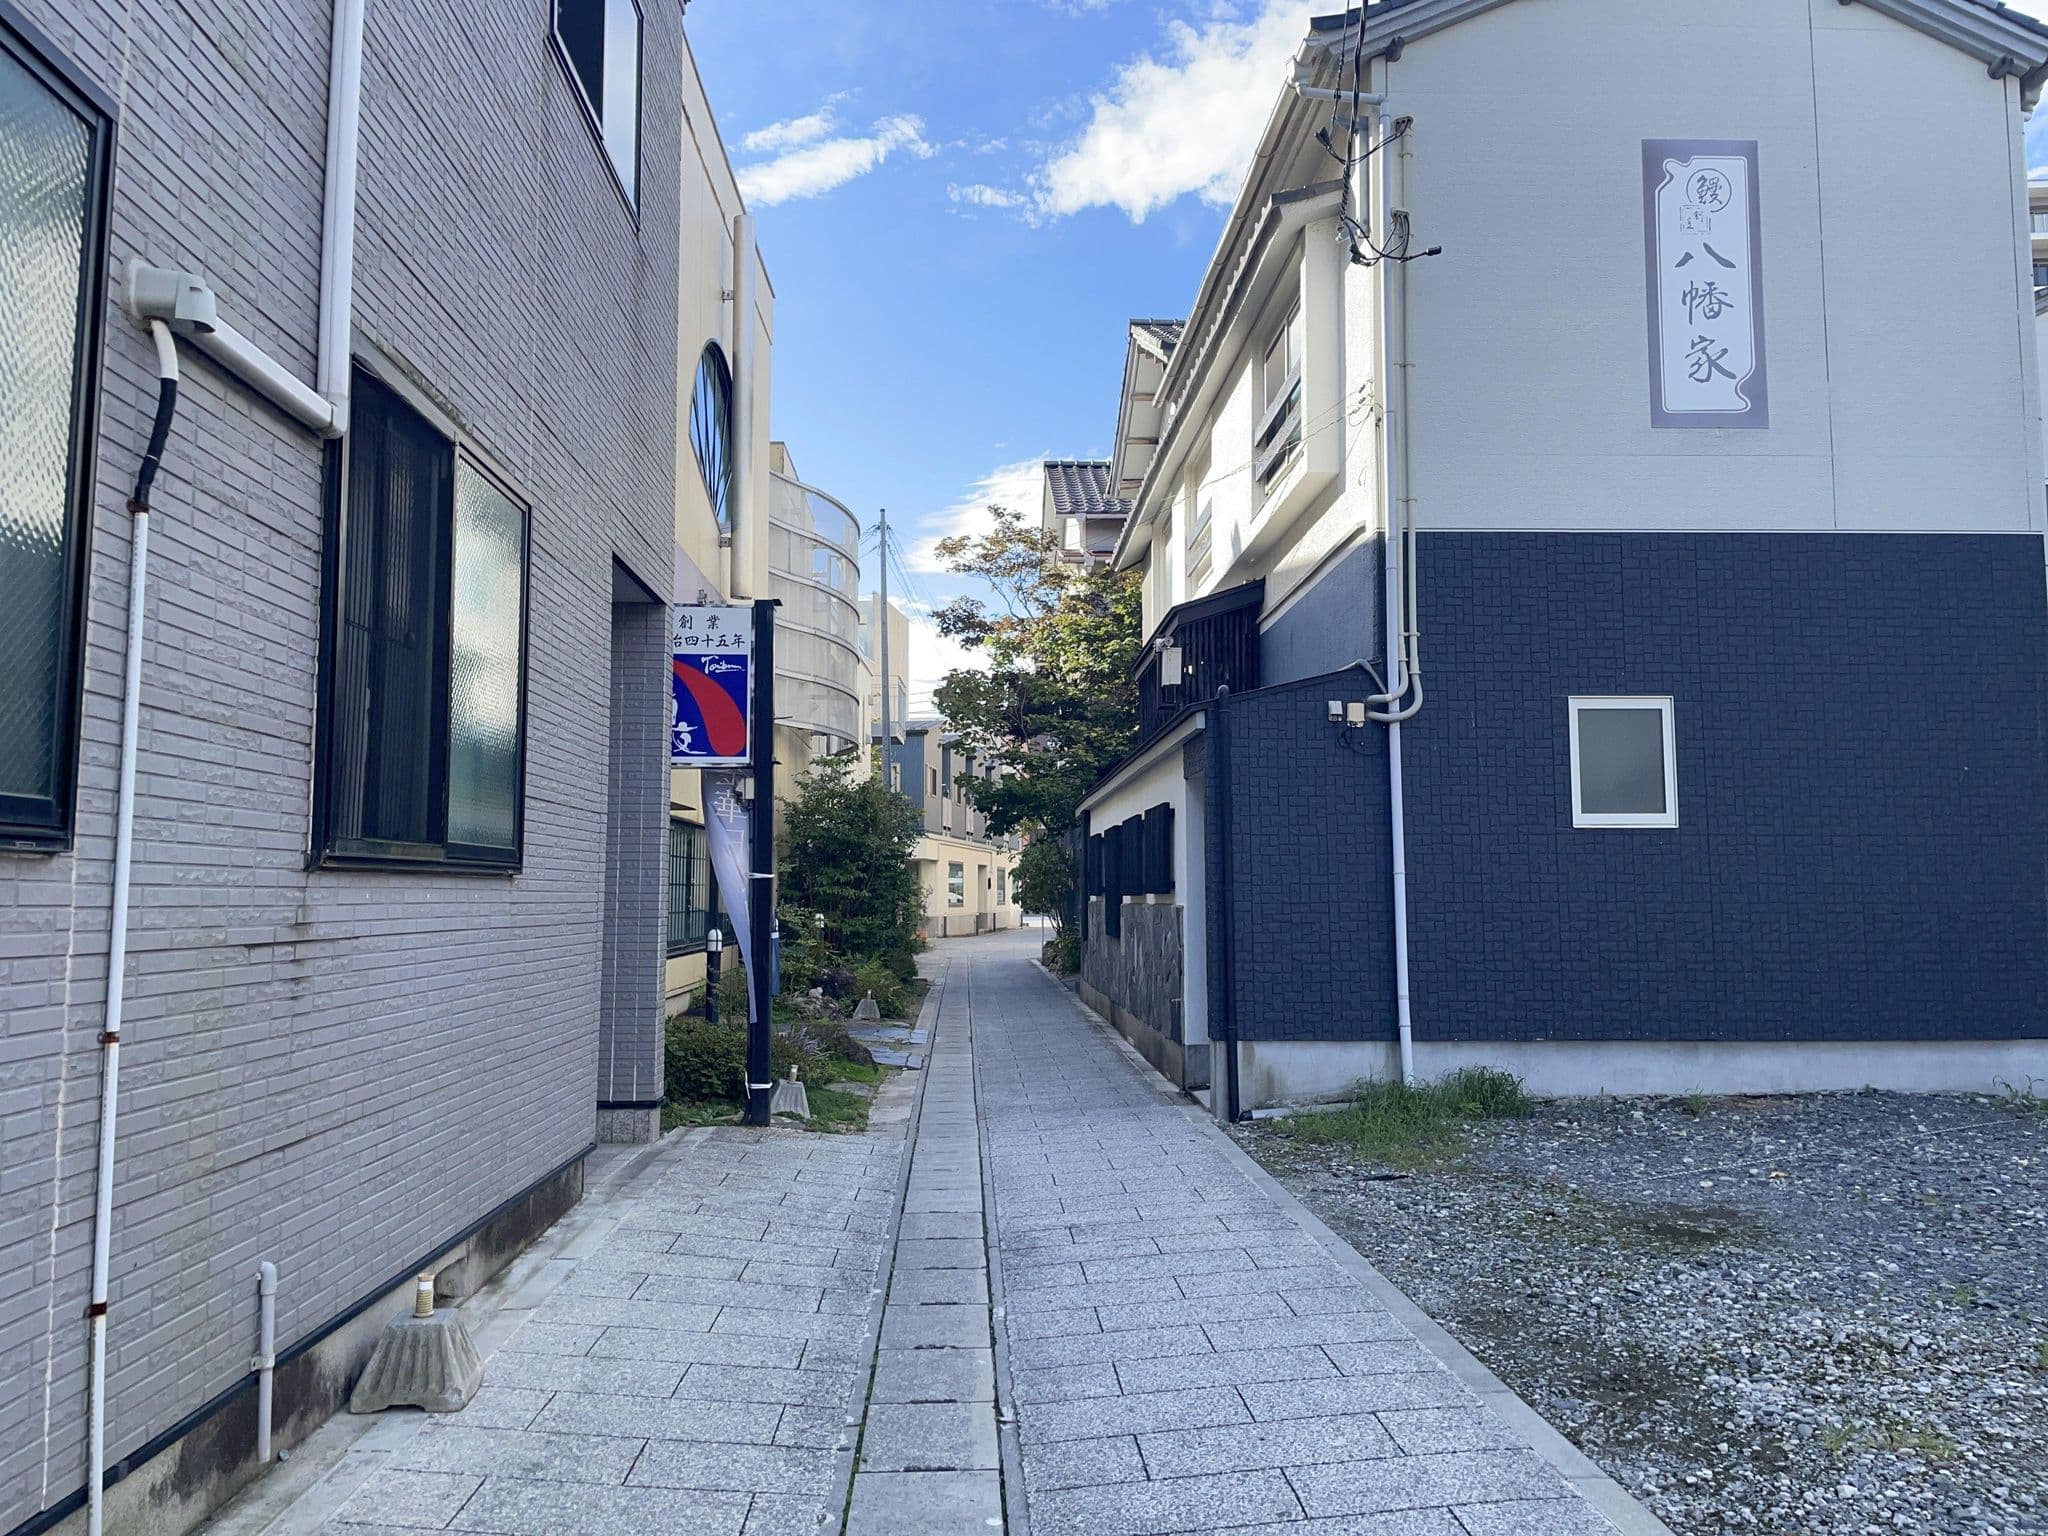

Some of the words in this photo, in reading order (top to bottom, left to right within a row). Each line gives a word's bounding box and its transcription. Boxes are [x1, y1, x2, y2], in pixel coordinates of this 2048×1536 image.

[1675, 242, 1737, 383] 八幡家
[679, 614, 720, 630] 創業
